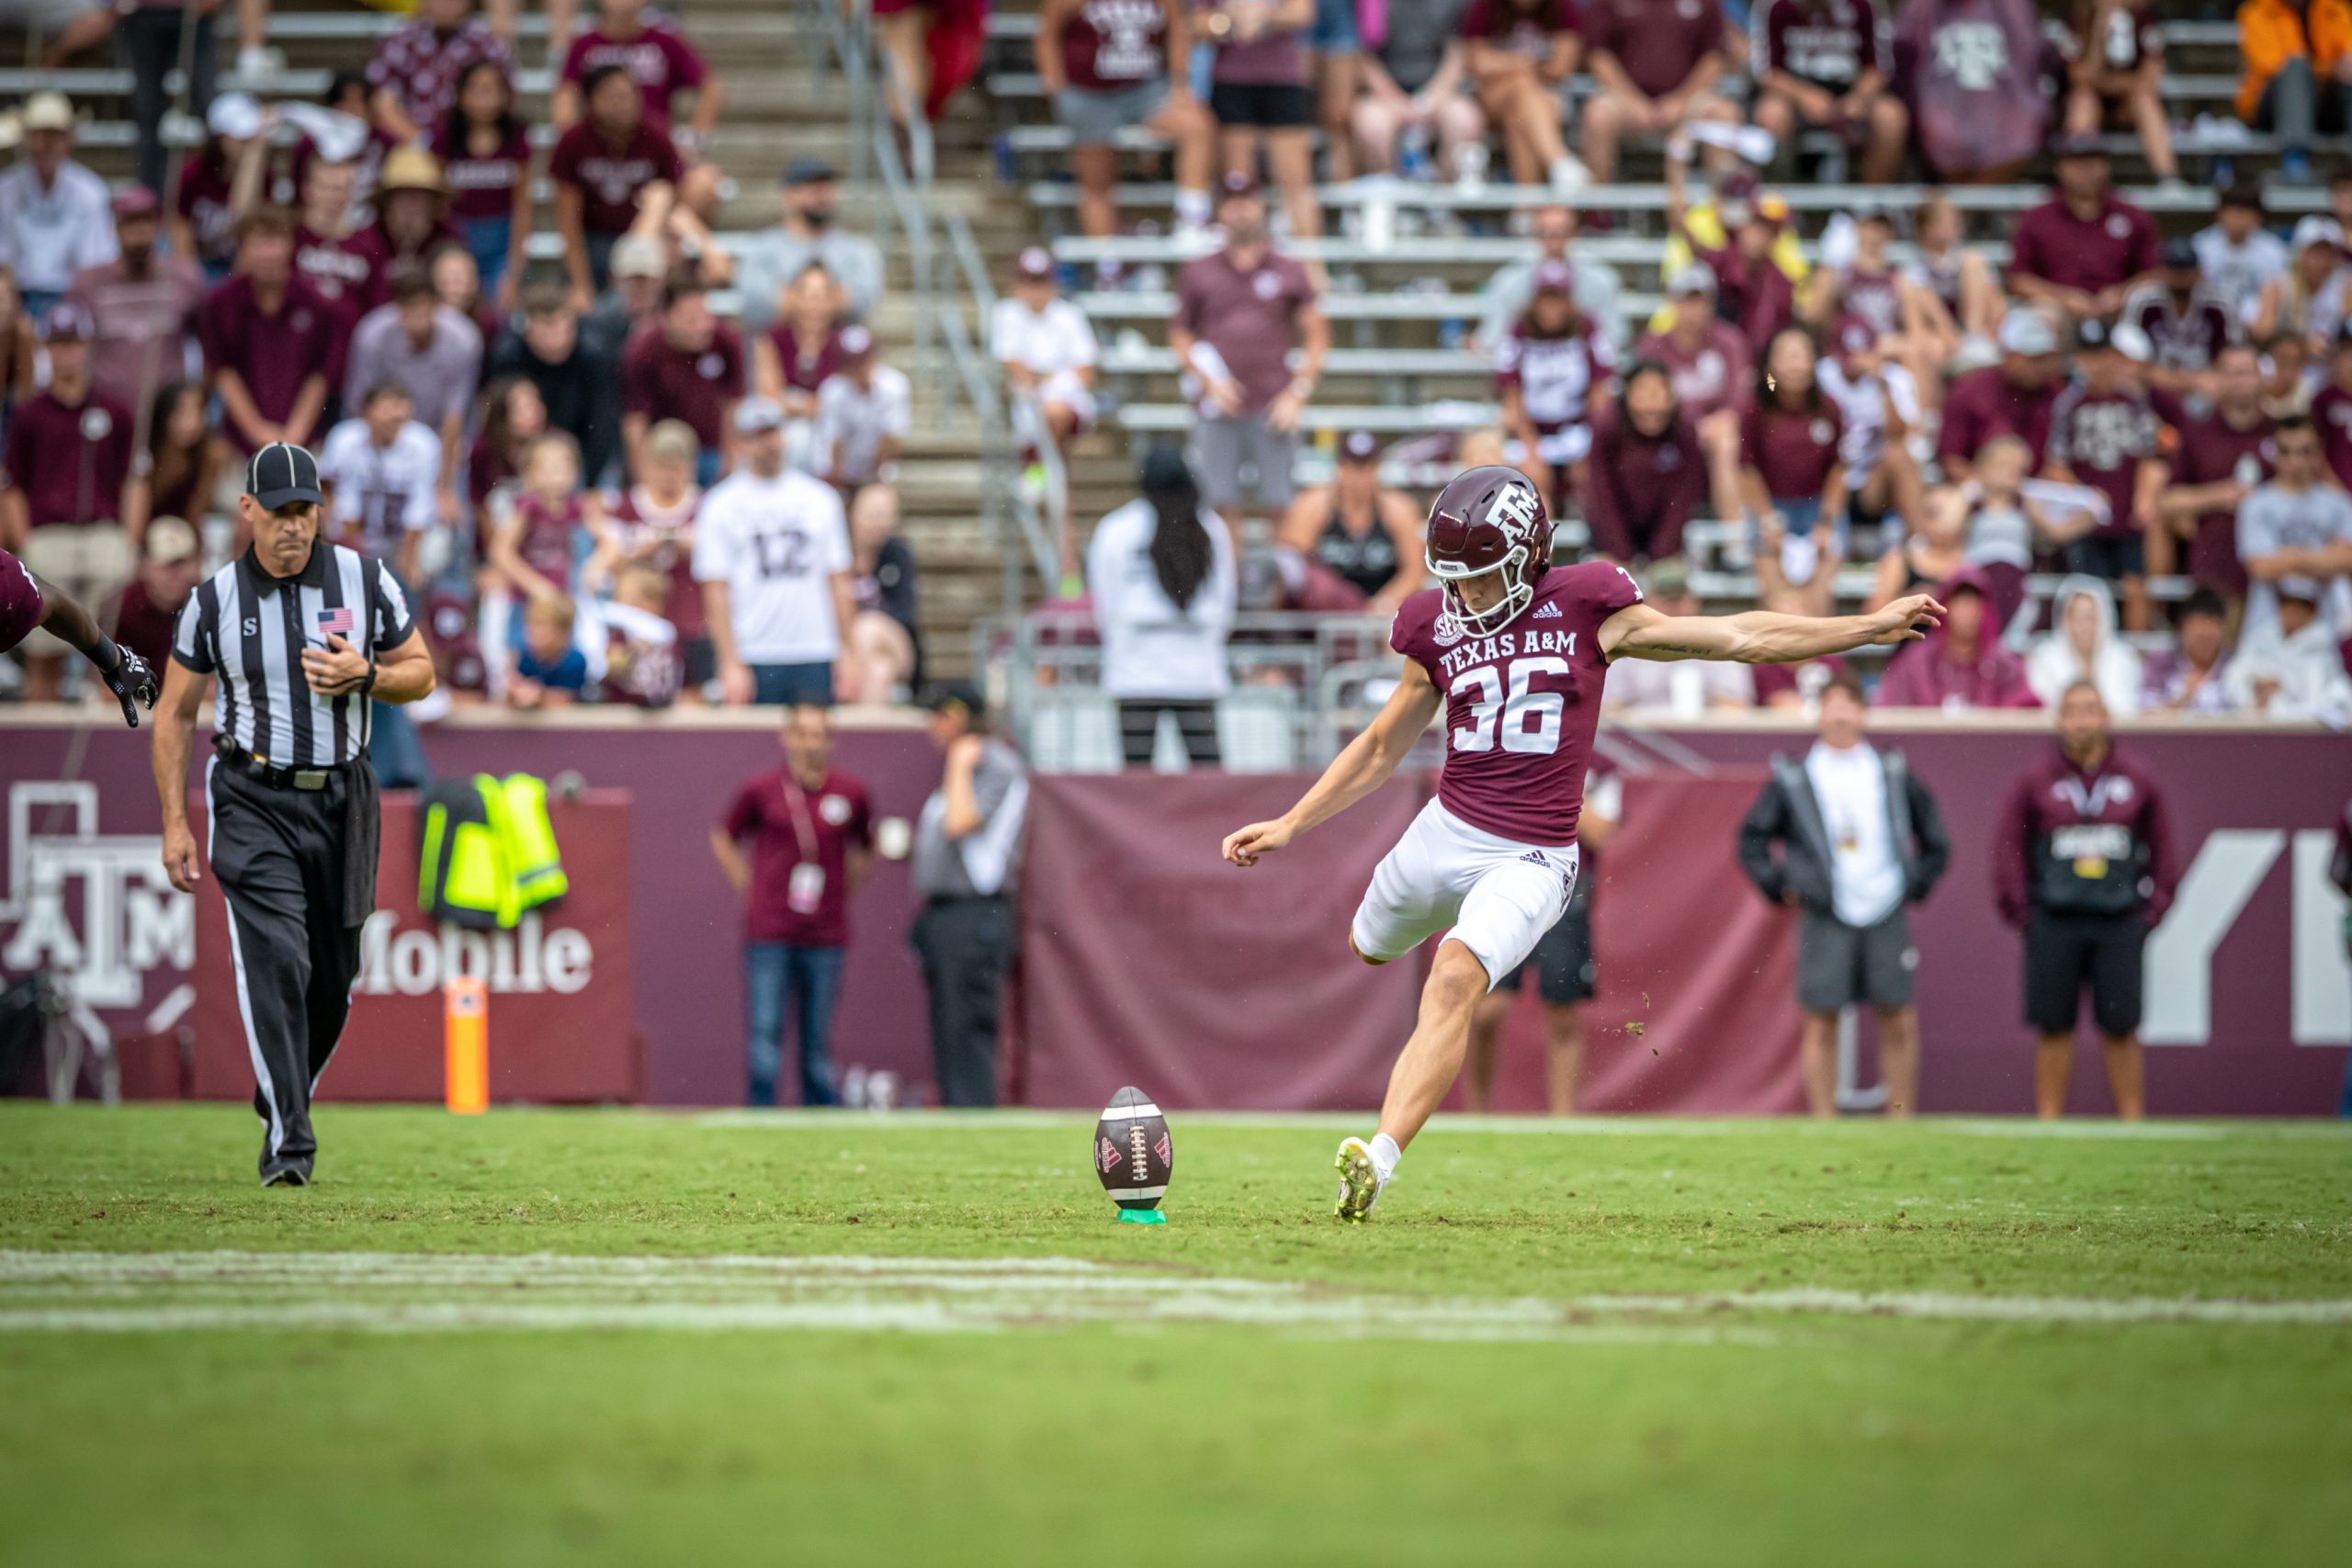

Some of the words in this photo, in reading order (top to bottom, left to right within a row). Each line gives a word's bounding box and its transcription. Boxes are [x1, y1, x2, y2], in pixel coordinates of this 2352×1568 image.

[751, 525, 811, 579] 12
[243, 617, 258, 637] S
[1532, 609, 1563, 619] adidas
[1439, 633, 1516, 678] TEXAS
[1523, 630, 1577, 656] A&M
[1450, 656, 1569, 755] 36
[1520, 855, 1551, 868] adidas
